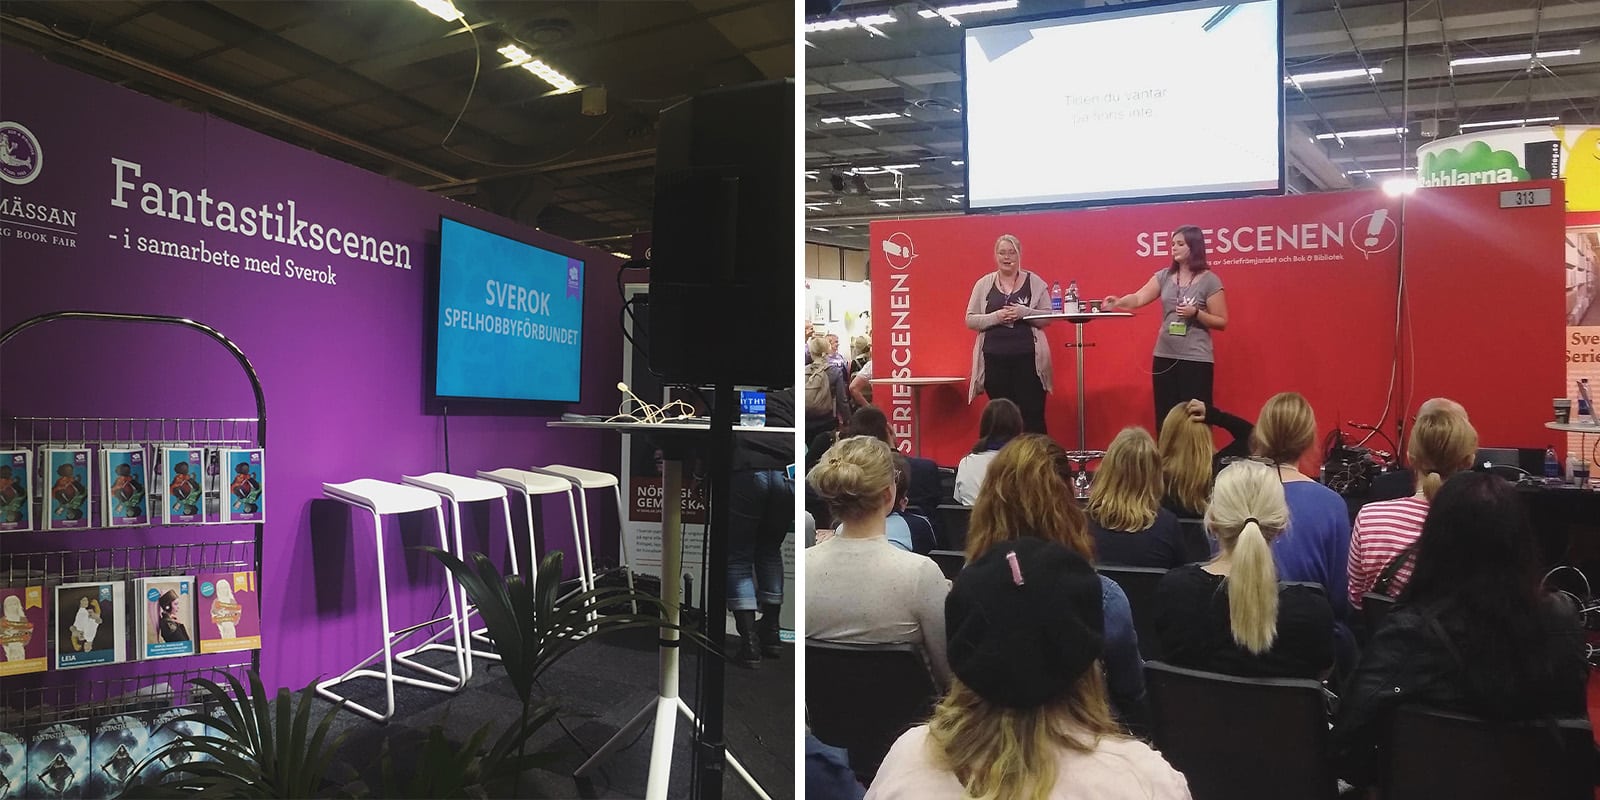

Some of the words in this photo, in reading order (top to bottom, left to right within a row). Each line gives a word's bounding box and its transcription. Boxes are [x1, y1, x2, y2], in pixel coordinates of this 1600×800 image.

[111, 157, 411, 270] Fantastikscenen
[1516, 191, 1534, 205] 313
[16, 230, 48, 243] BOOK
[53, 236, 77, 249] FAIR
[123, 228, 131, 249] i
[137, 236, 240, 269] samarbete
[244, 256, 280, 276] med
[285, 259, 336, 285] Sverok
[1136, 222, 1344, 257] SEESCENEN
[1278, 255, 1292, 263] och
[485, 279, 551, 317] SVEROK
[444, 307, 578, 345] SPELHOBBYFÖRBUNDET
[890, 274, 912, 453] SERIESCENEN
